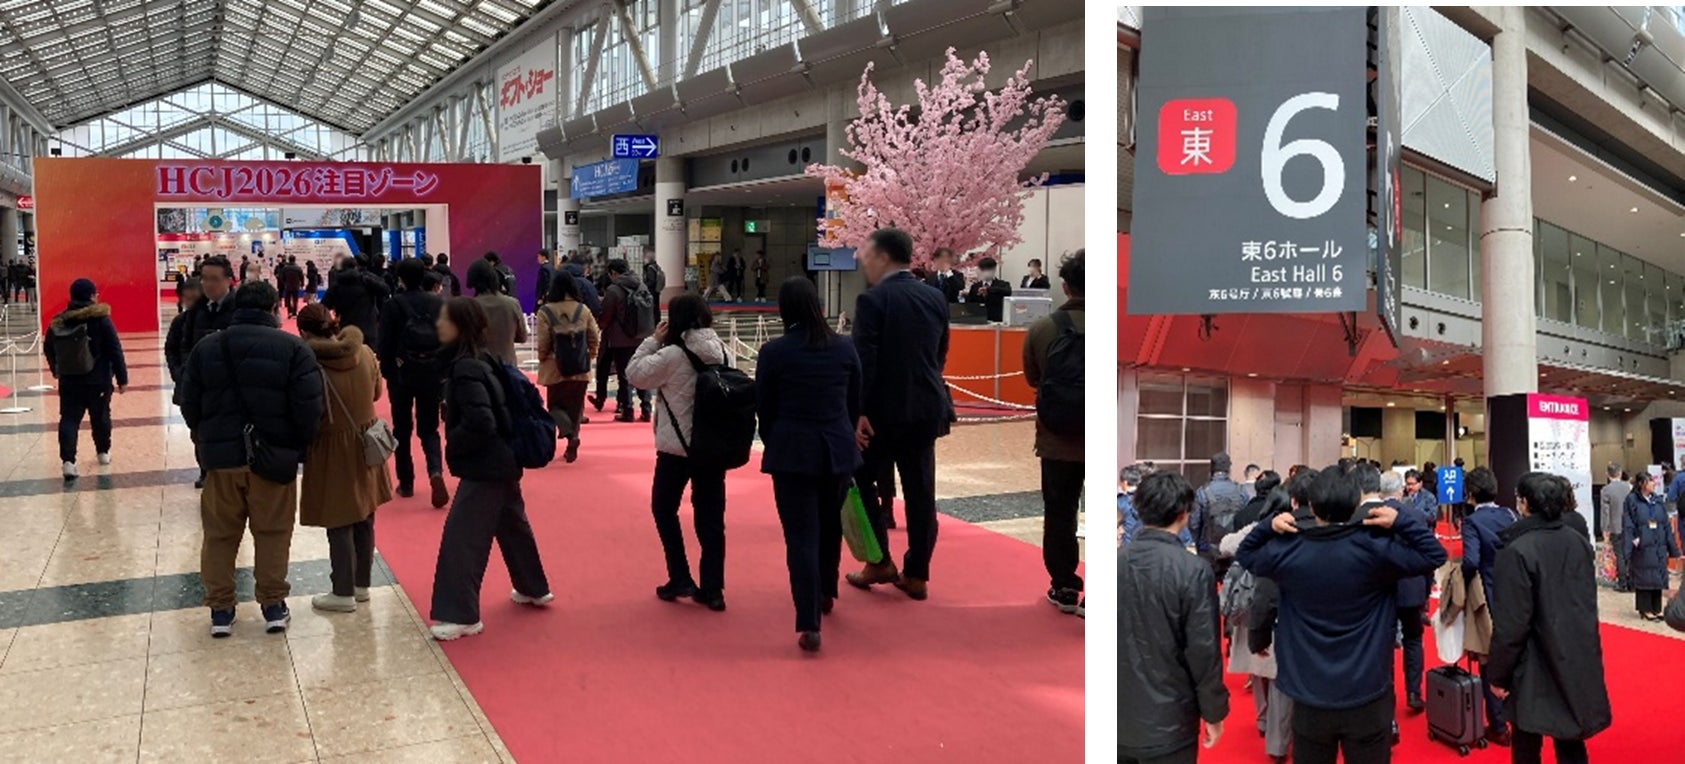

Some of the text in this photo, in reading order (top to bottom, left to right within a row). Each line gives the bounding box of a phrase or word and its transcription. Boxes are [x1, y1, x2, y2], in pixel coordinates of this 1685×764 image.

[1183, 109, 1213, 121] East
[615, 138, 629, 155] 西
[1180, 126, 1213, 166] 東
[1261, 91, 1345, 219] 6
[157, 165, 439, 198] HCJ2026注目ゾーン
[1241, 240, 1343, 261] 東6ホール
[1251, 264, 1343, 282] East Hall 6
